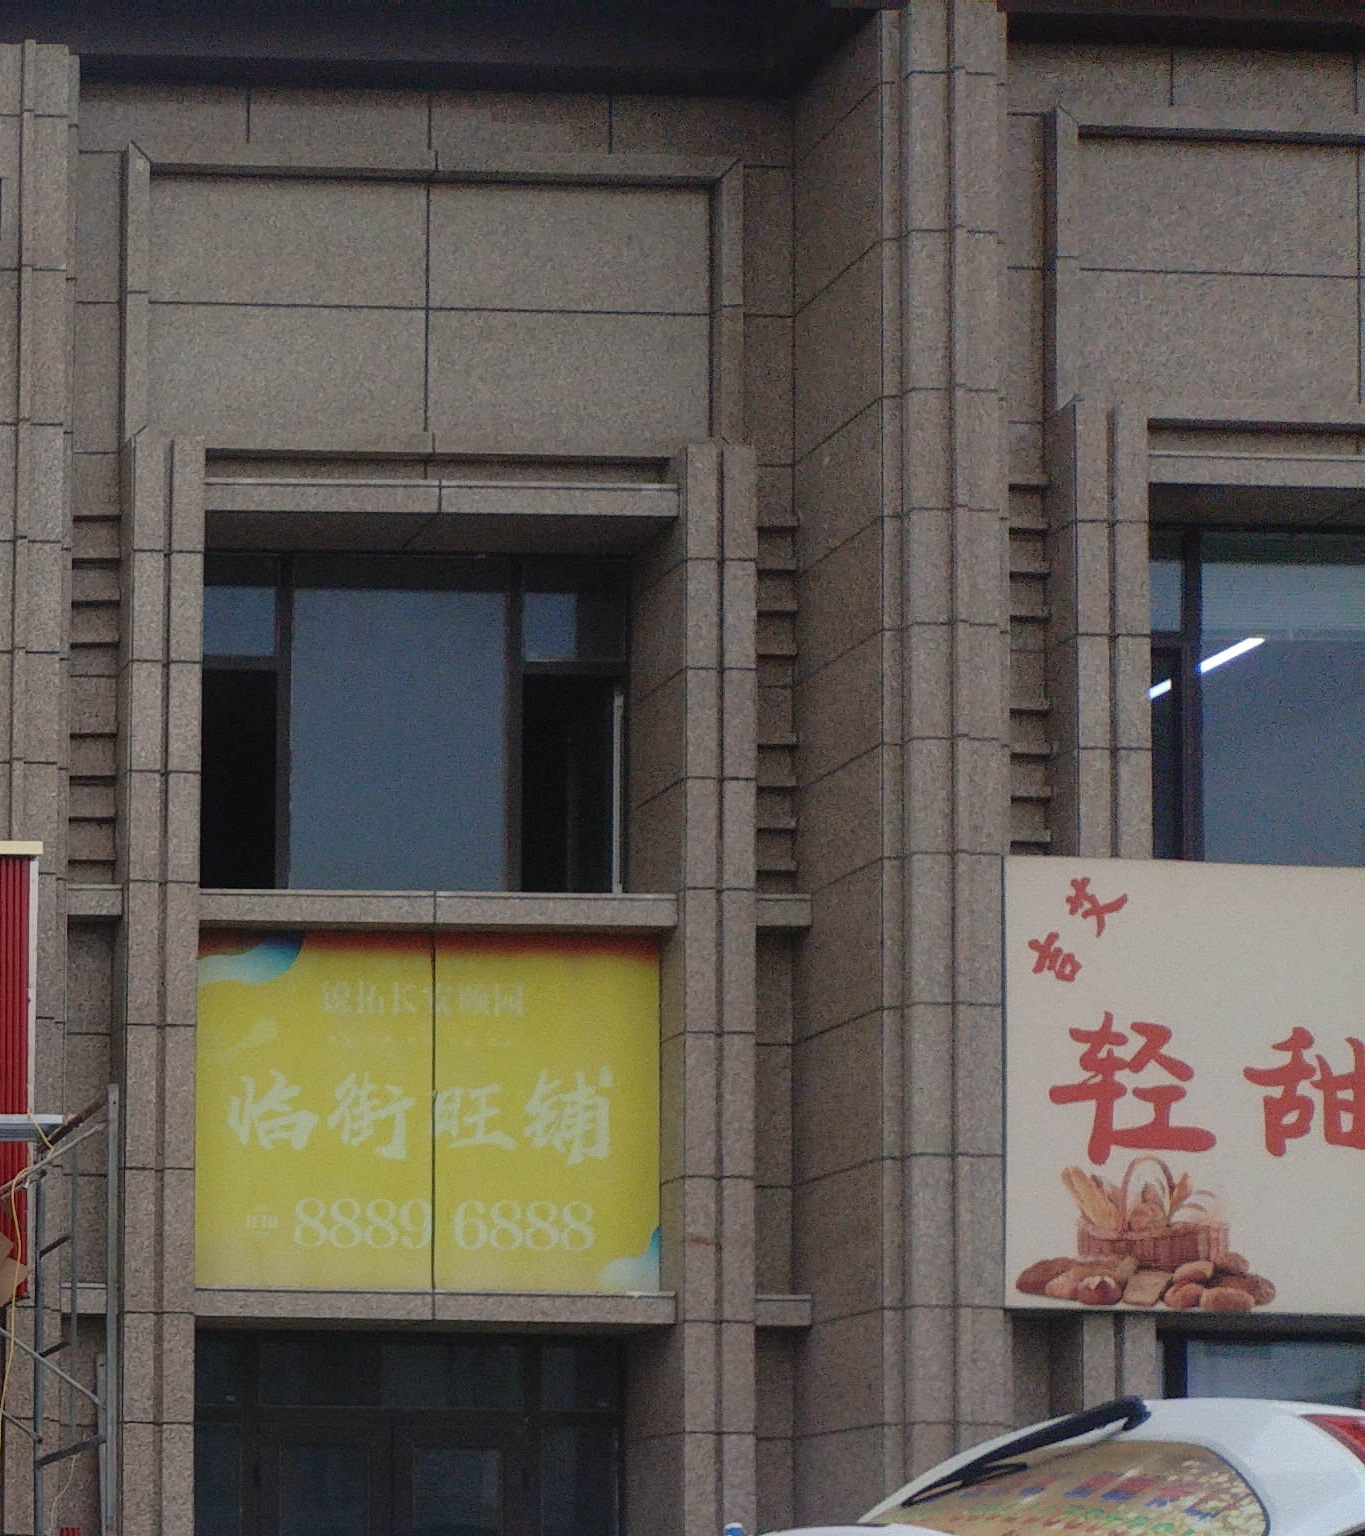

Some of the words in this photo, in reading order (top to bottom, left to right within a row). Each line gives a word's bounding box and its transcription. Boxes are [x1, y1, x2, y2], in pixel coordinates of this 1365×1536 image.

[226, 1065, 613, 1167] 临街旺铺
[292, 1198, 431, 1251] 8889
[452, 1198, 596, 1253] 6888
